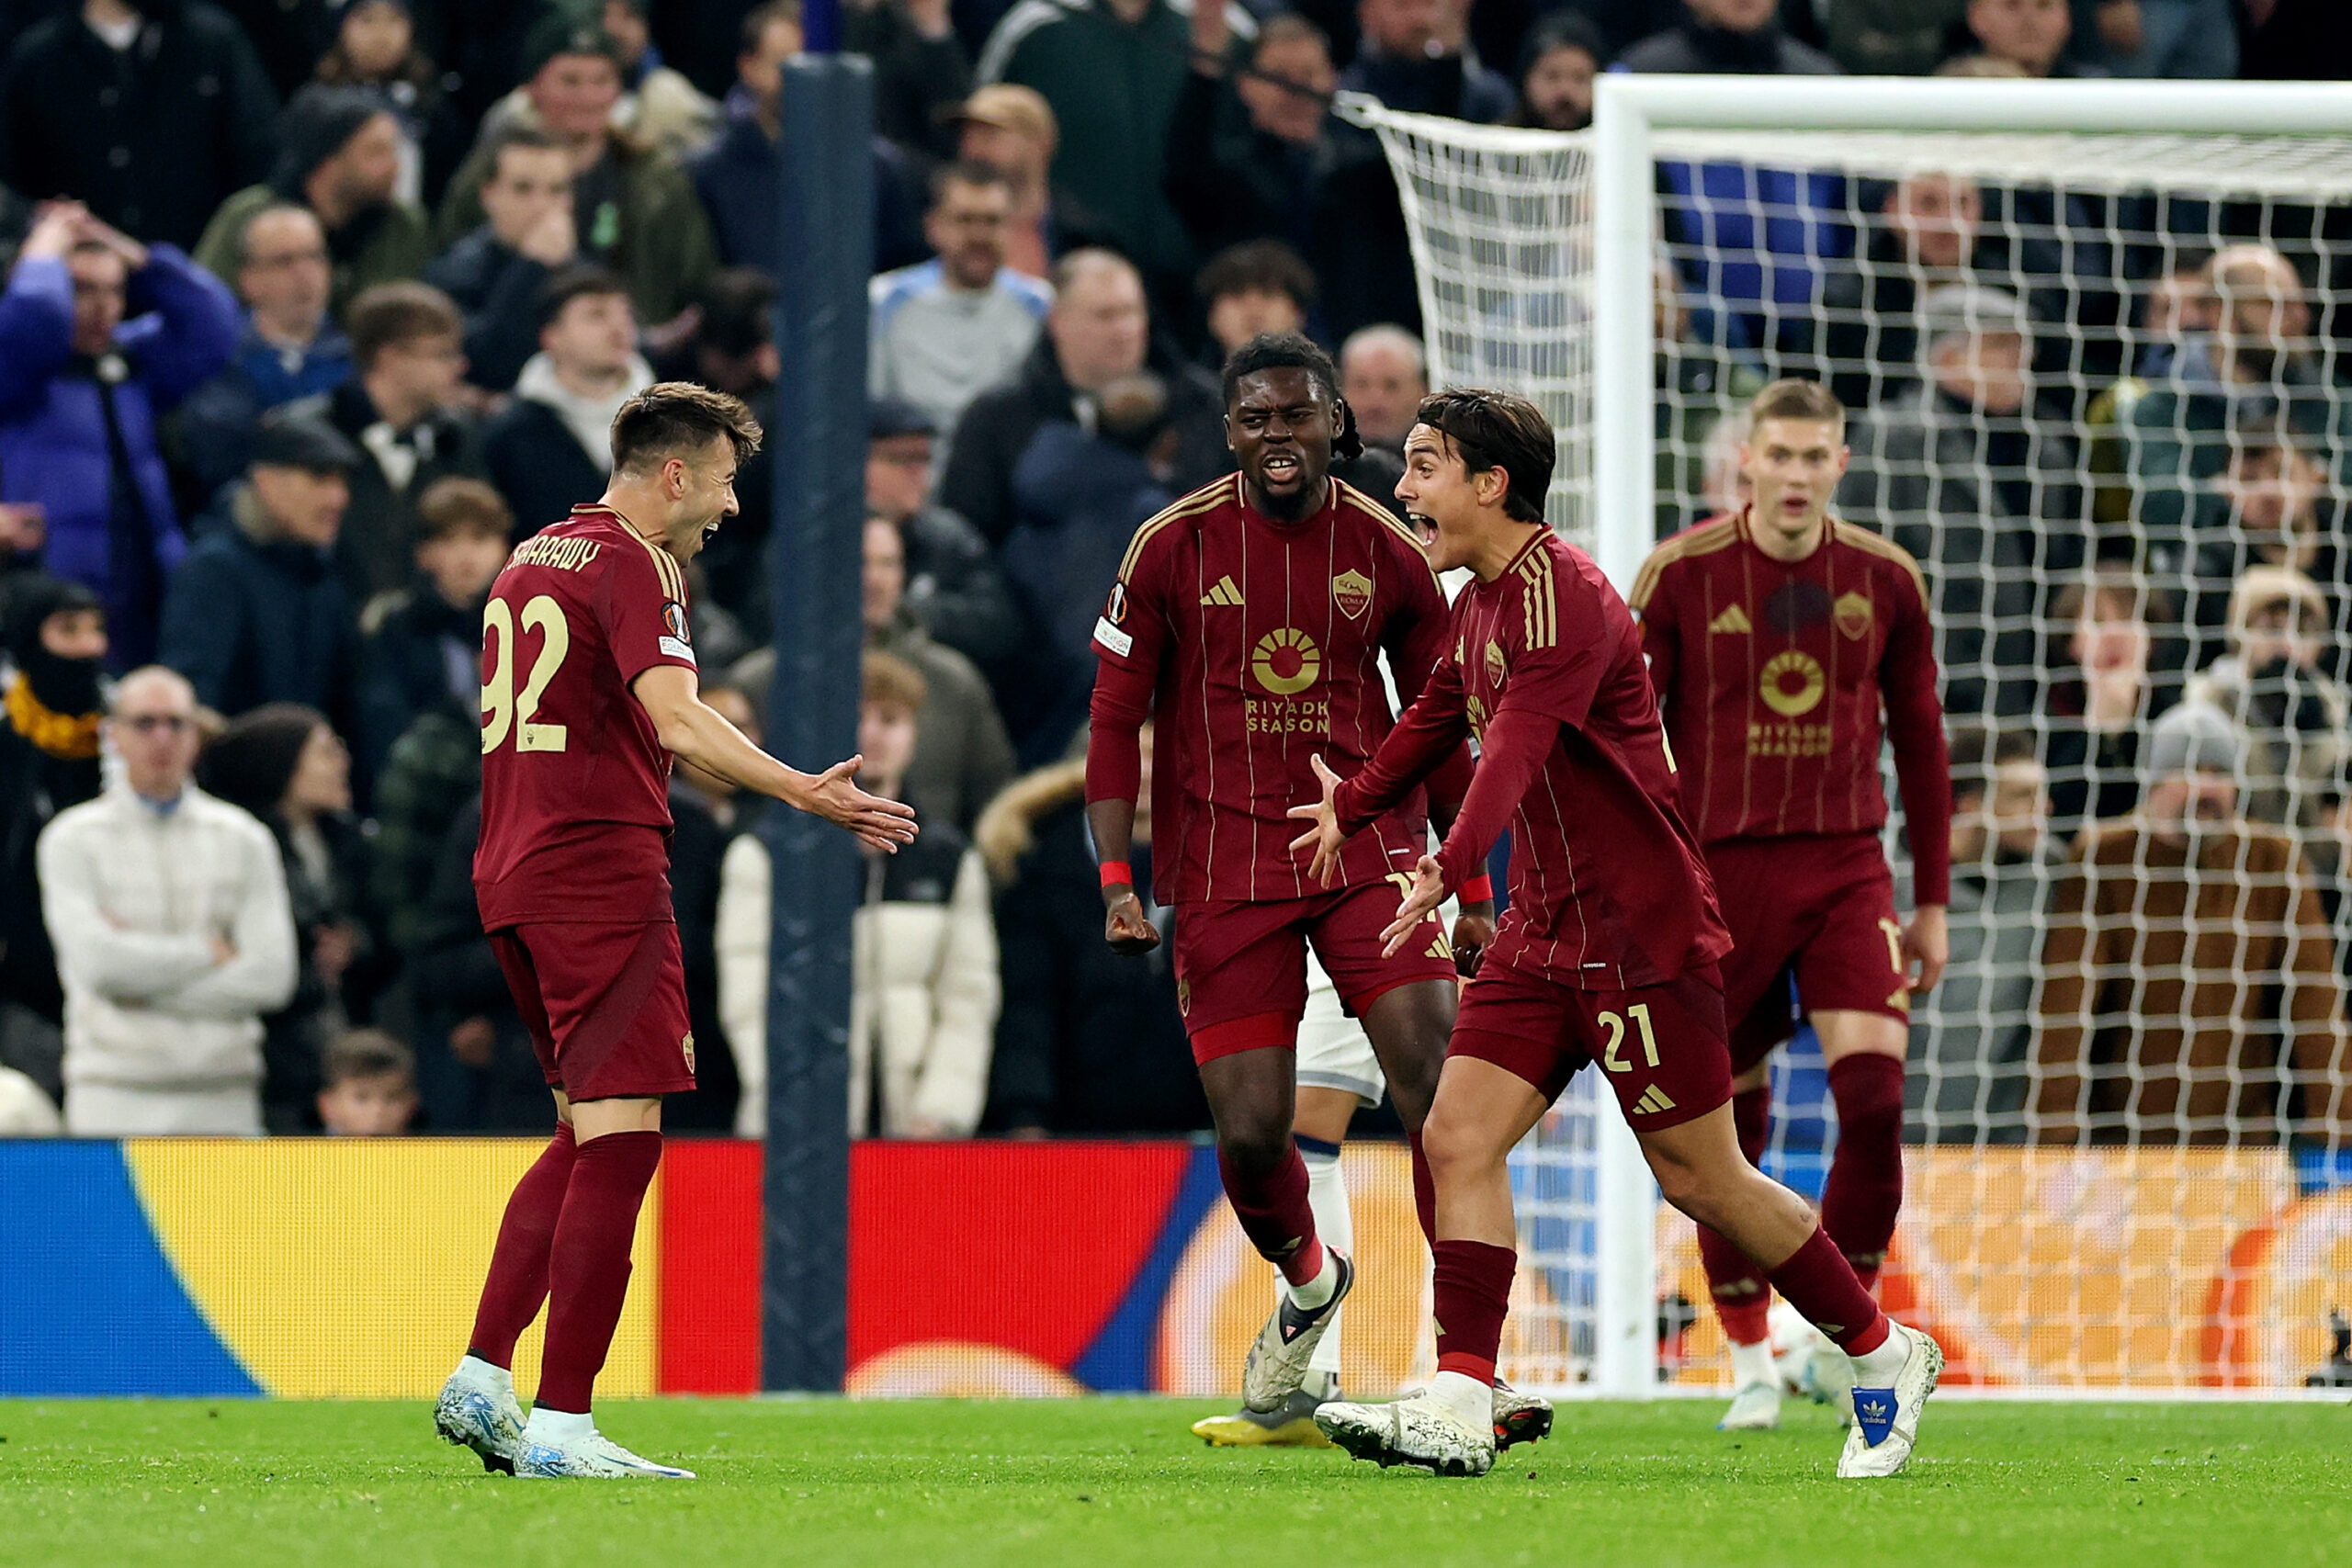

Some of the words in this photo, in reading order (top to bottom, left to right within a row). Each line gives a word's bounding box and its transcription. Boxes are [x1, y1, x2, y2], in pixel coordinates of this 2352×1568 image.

[481, 595, 569, 754] 92
[1248, 699, 1329, 716] RIYADH
[1248, 717, 1329, 734] SEASON
[1597, 1003, 1661, 1072] 21
